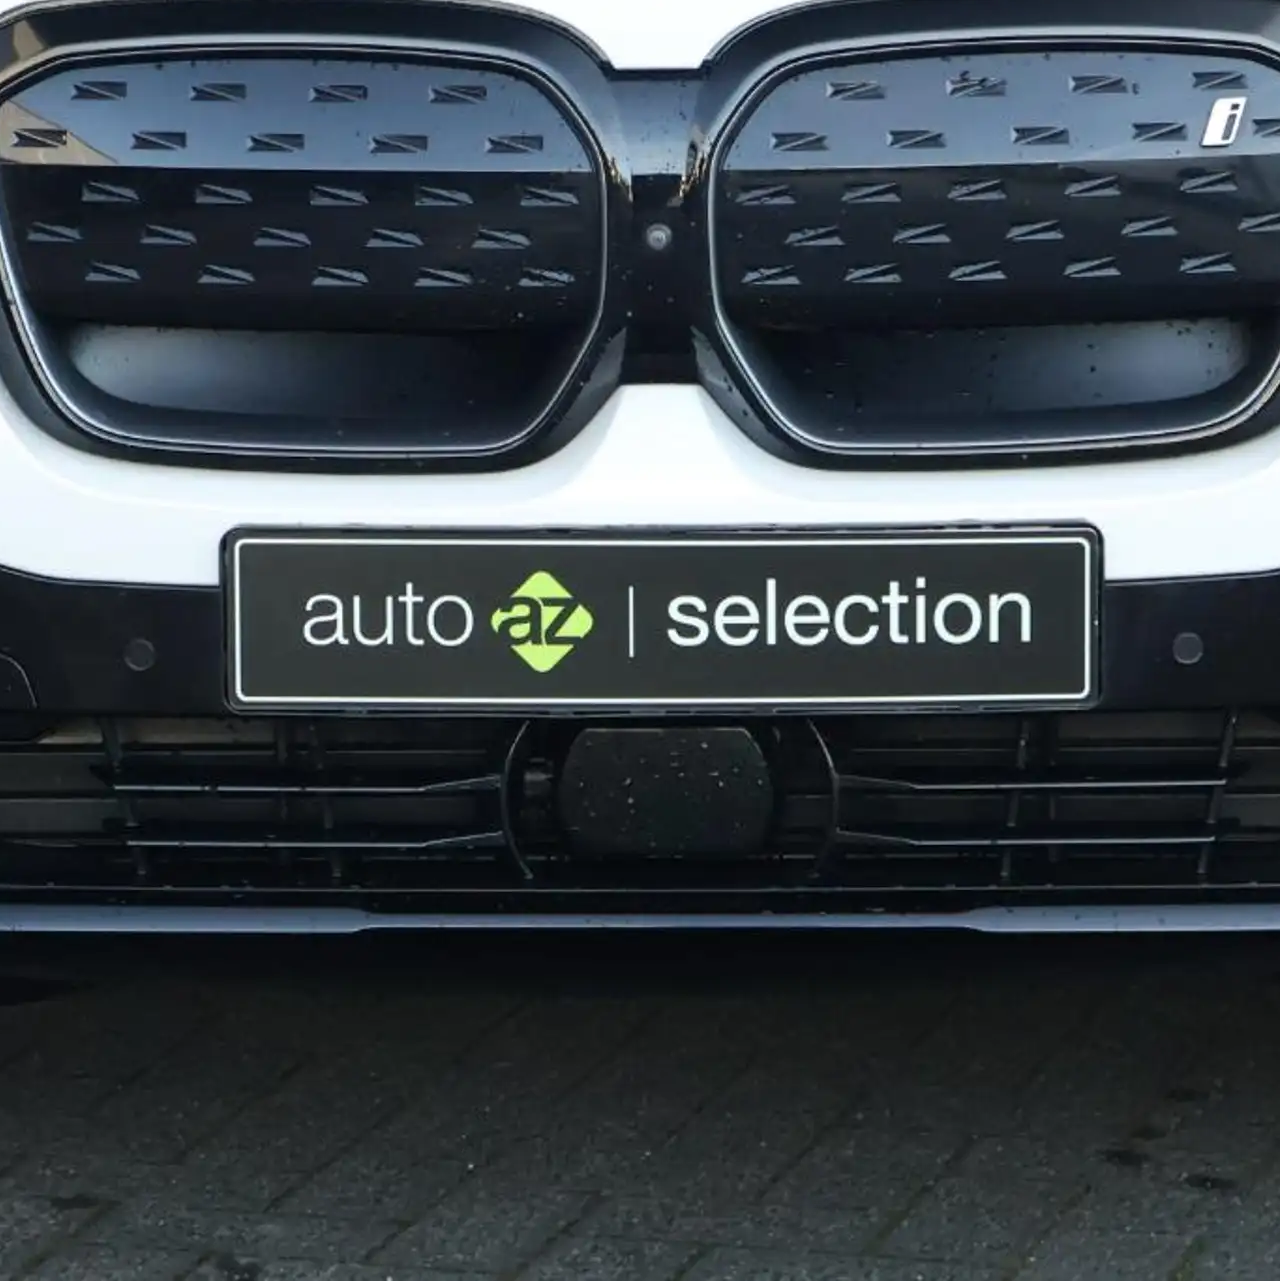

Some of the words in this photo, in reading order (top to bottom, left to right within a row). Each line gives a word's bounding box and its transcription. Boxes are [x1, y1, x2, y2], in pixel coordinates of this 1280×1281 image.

[302, 581, 475, 647] auto
[497, 596, 584, 646] az
[666, 576, 1032, 648] selection
